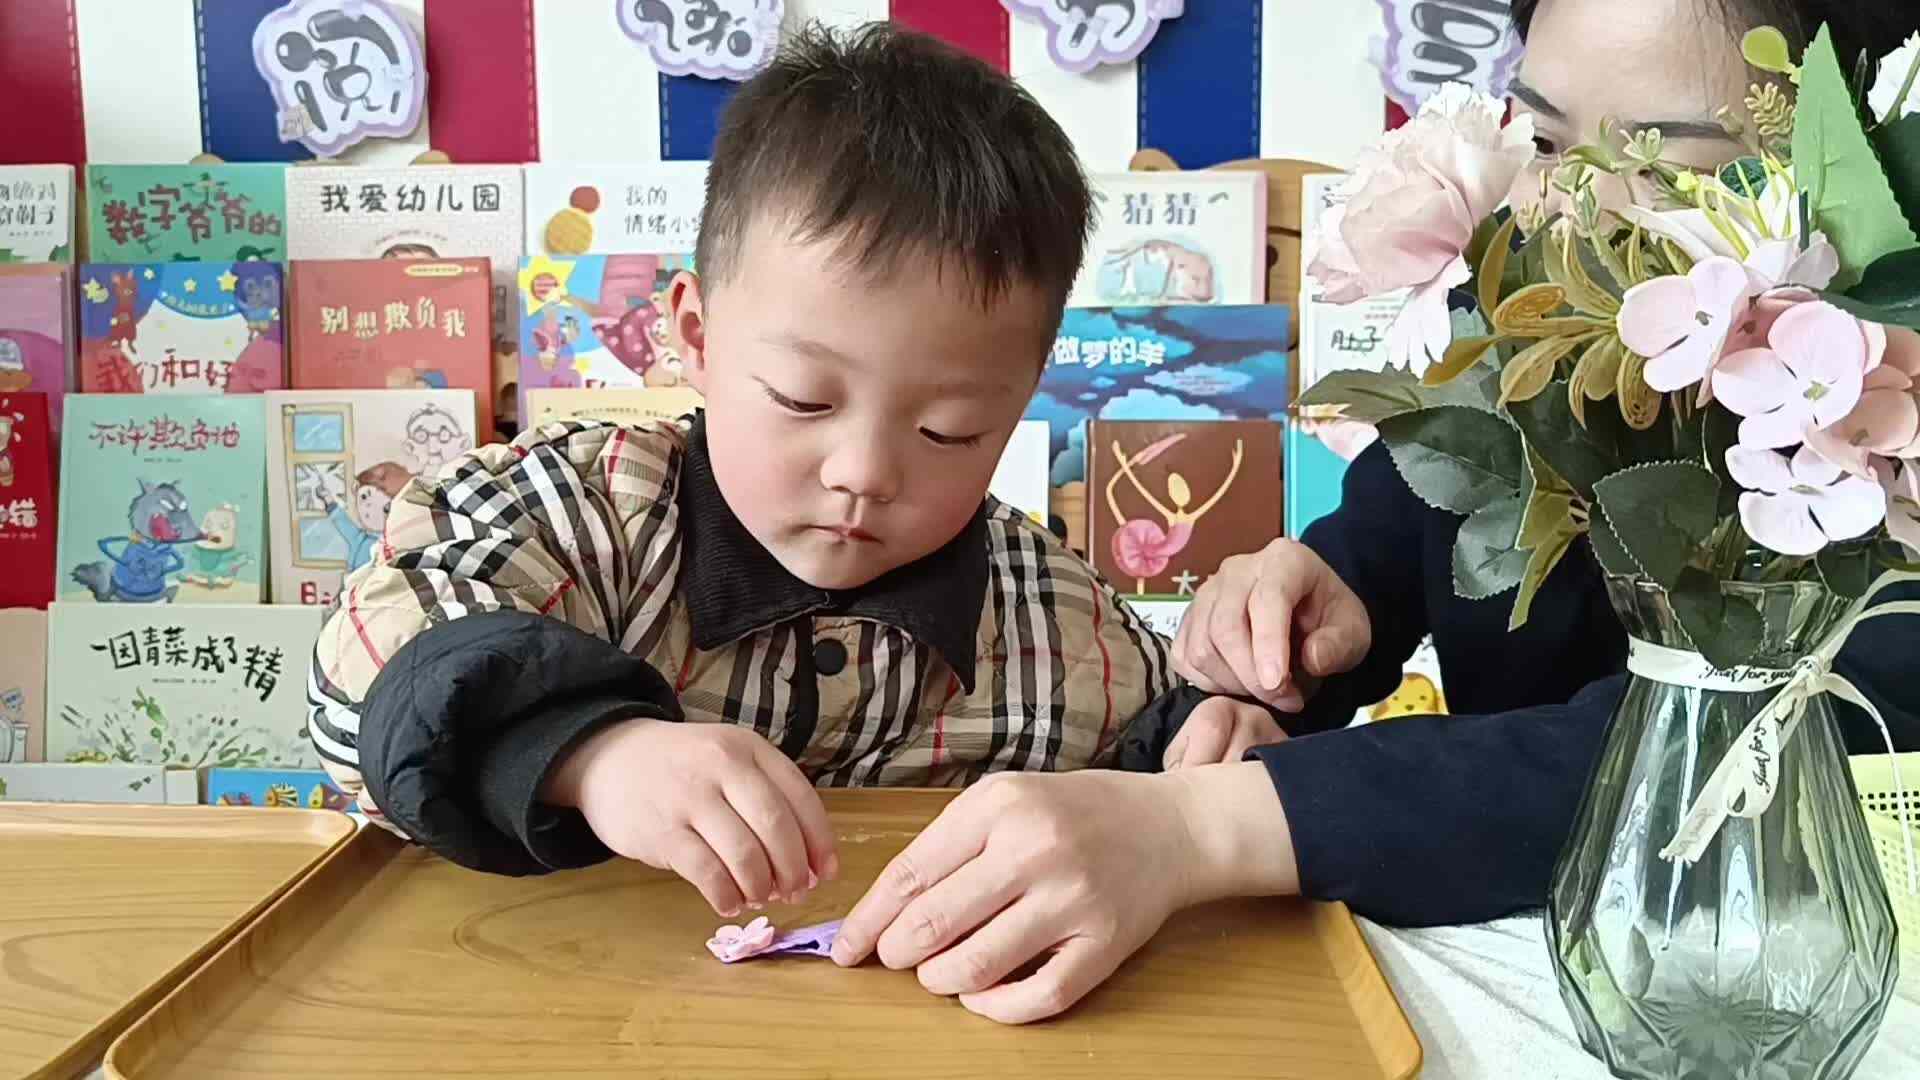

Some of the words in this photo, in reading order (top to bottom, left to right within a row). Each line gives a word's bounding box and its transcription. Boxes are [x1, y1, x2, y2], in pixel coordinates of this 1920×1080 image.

[320, 183, 500, 213] 我爱幼儿园
[625, 185, 668, 206] 我的
[1122, 192, 1198, 226] 猜猜
[320, 296, 466, 338] 别想欺负我
[89, 625, 284, 703] 一园青菜成了精
